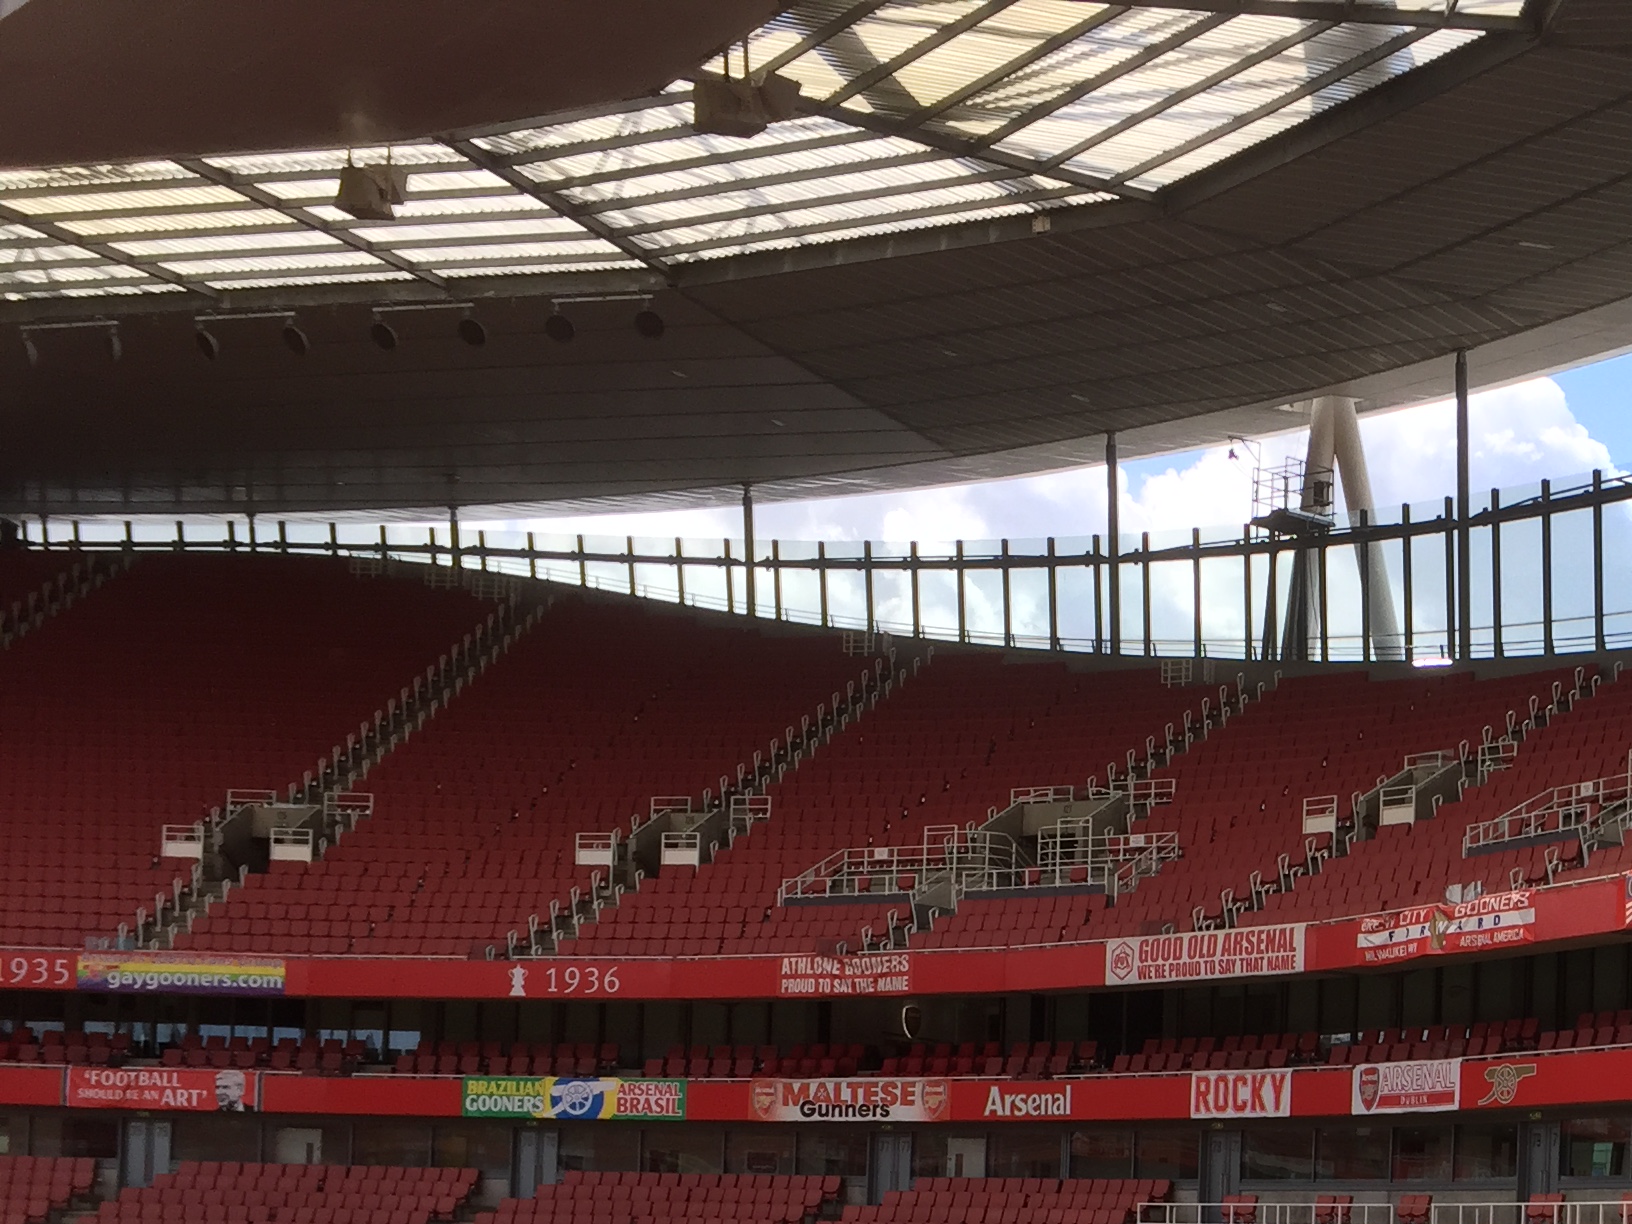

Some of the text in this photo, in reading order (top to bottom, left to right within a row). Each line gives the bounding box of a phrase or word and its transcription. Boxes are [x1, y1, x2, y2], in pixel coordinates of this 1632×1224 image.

[1399, 908, 1430, 926] CITY
[1138, 927, 1297, 964] GOOD OLD ARSENAL
[1493, 928, 1524, 943] AMERICA
[0, 957, 70, 984] 935
[781, 954, 909, 976] ATHLONE GOONERS
[1169, 961, 1200, 979] PROUD
[1204, 960, 1216, 976] TO
[1218, 957, 1237, 975] SAY
[1238, 955, 1264, 973] THAT
[1266, 954, 1297, 971] NAME
[107, 969, 283, 990] gaygooners.com
[546, 966, 620, 993] 1936
[781, 975, 909, 993] PROUD TO SAY THE NAME
[1380, 1062, 1455, 1092] ARSENAL
[467, 1080, 545, 1096] BRAZILIAN
[617, 1081, 682, 1098] ARSENAL
[782, 1081, 916, 1107] MALTESE
[1193, 1073, 1288, 1115] ROCKY
[465, 1095, 545, 1113] GOONERS
[616, 1096, 683, 1116] BRASIL
[800, 1100, 890, 1118] Gunners
[984, 1084, 1072, 1117] Arsenal
[1400, 1094, 1428, 1105] DUBLIN
